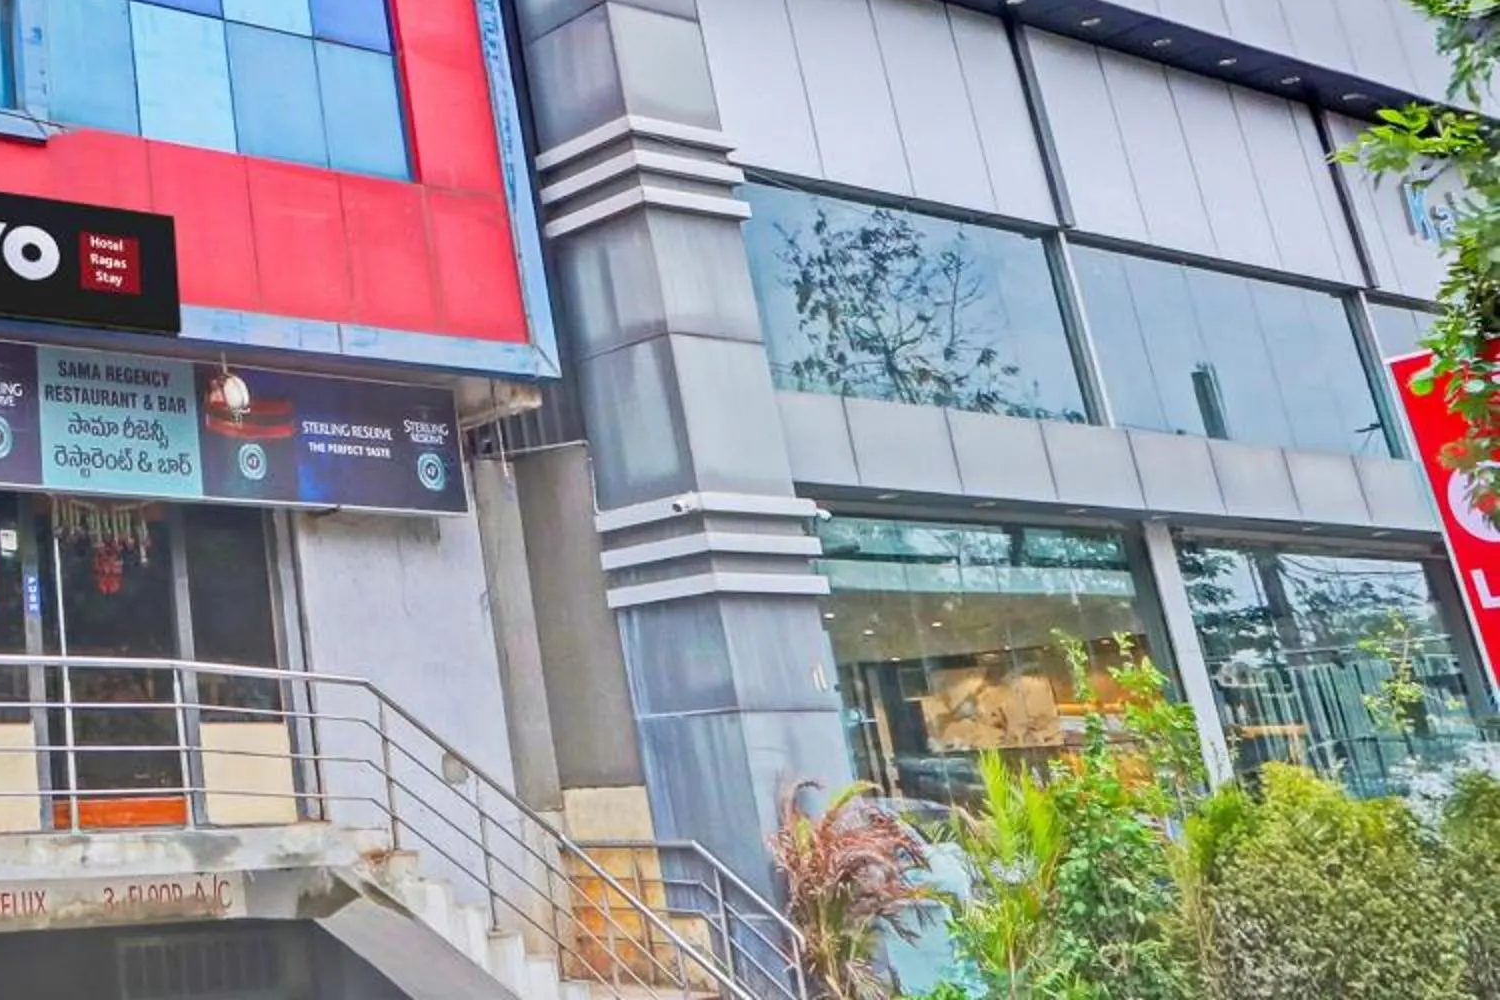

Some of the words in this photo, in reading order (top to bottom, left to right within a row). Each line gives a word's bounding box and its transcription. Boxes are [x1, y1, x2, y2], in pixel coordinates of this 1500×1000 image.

[90, 235, 124, 251] Hotel
[90, 253, 128, 269] Ragas
[96, 271, 124, 287] Stay
[58, 360, 100, 380] SAMA
[105, 365, 170, 387] REGENCY
[44, 385, 138, 409] RESTAURANT
[143, 394, 153, 411] &
[158, 396, 187, 414] BAR
[302, 421, 350, 437] STERLING
[352, 425, 393, 441] RESERVE
[308, 442, 325, 453] THE
